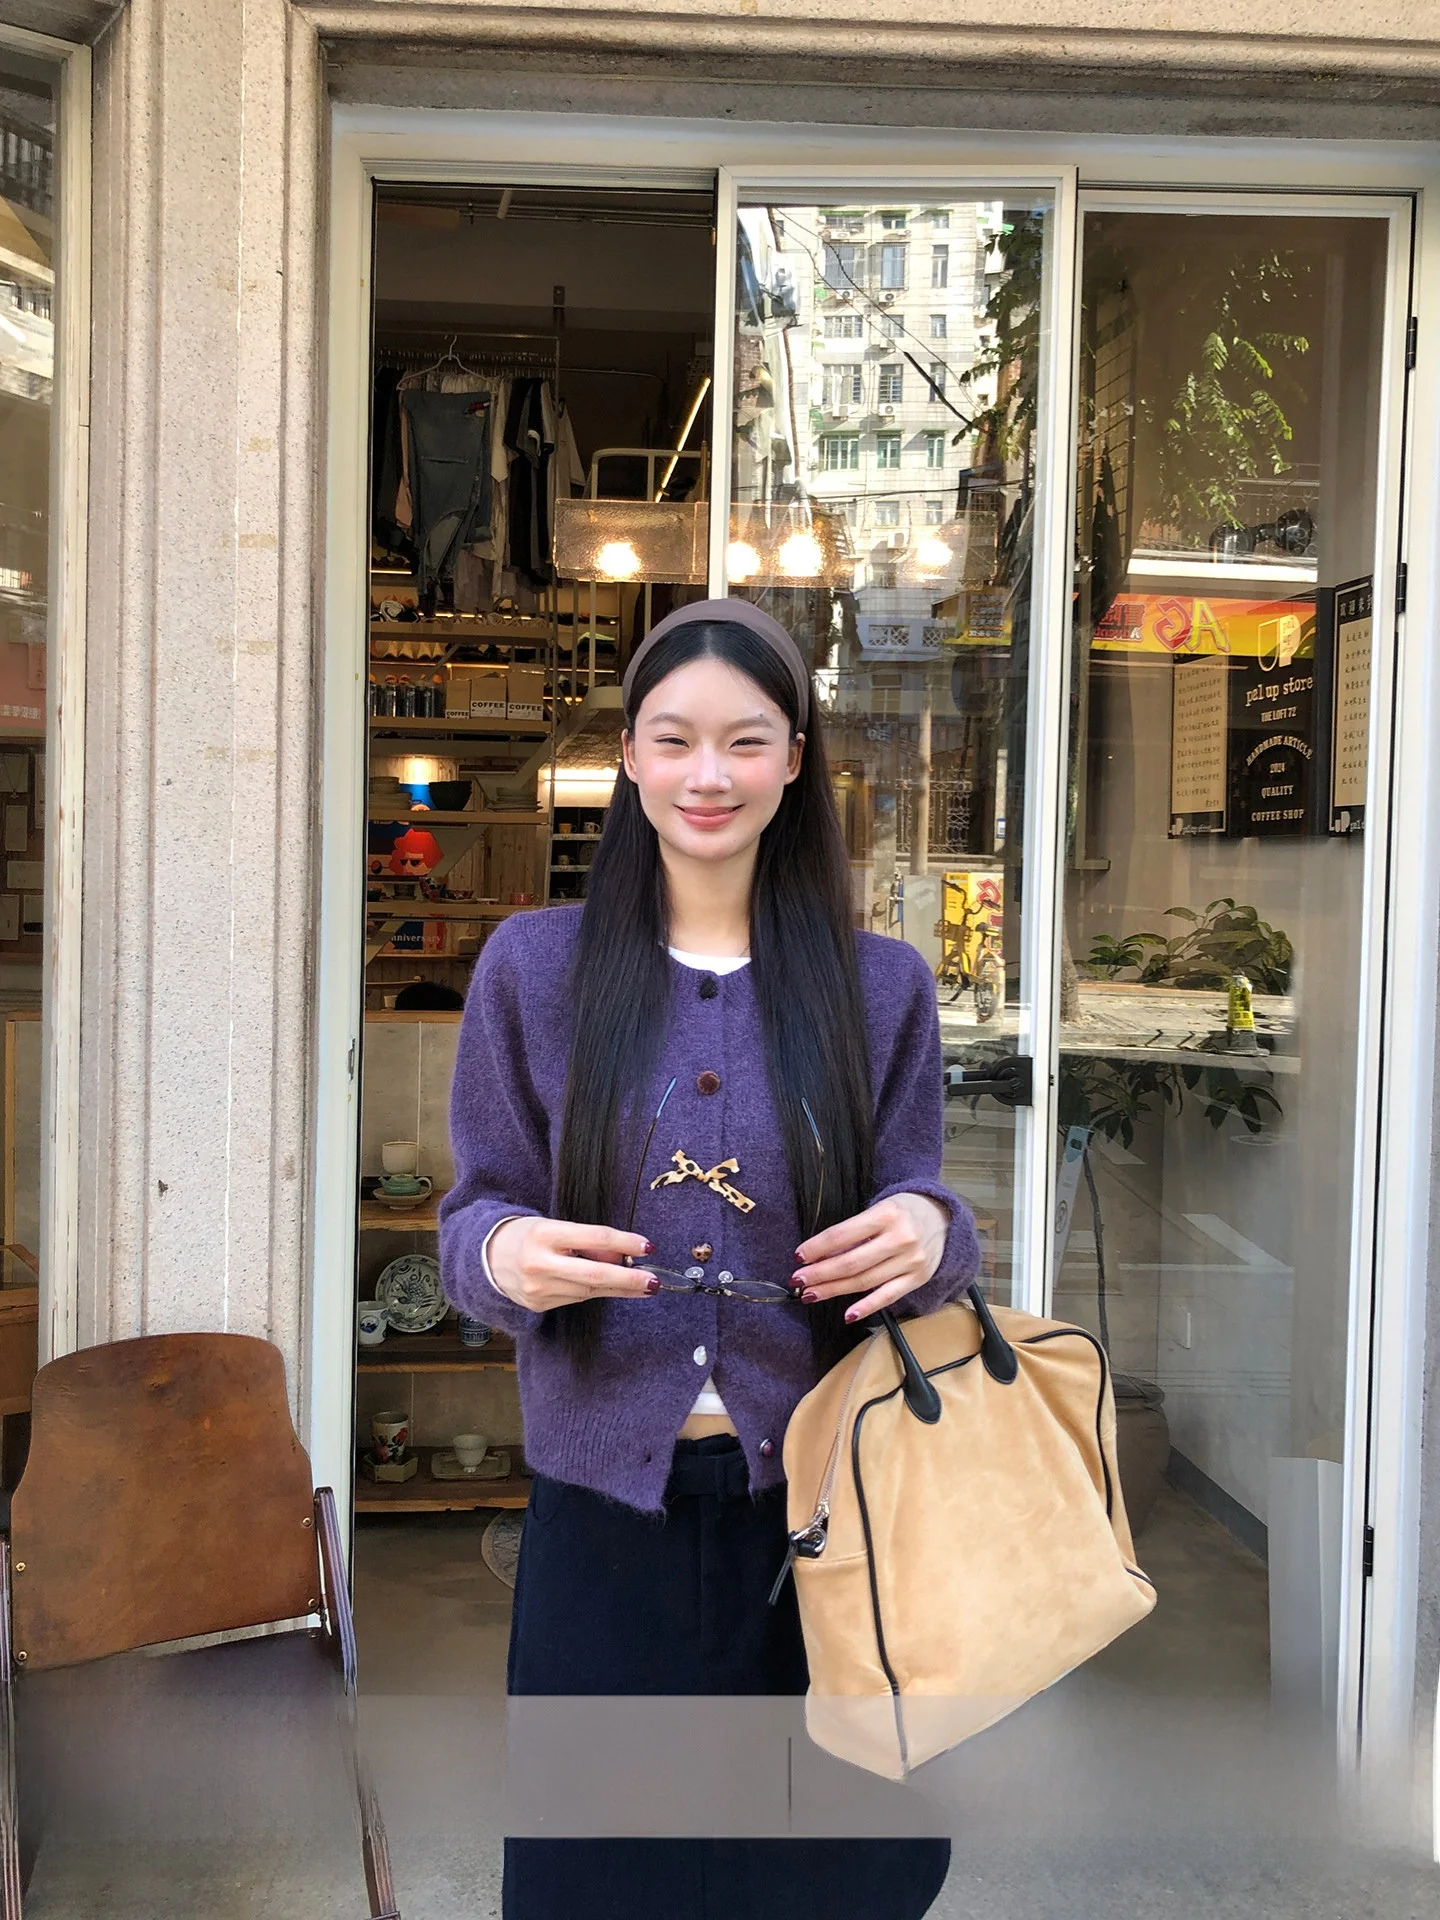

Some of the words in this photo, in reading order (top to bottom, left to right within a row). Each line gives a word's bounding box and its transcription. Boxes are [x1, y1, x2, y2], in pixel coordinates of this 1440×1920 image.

[1265, 685, 1279, 701] up
[1282, 677, 1313, 695] store
[1288, 706, 1296, 717] 72
[1246, 735, 1282, 766] HANDMADE
[1282, 736, 1313, 760] ARTICLE
[1261, 785, 1294, 799] QUALITY
[1251, 810, 1281, 822] COFFEE
[1283, 808, 1305, 820] SHOP
